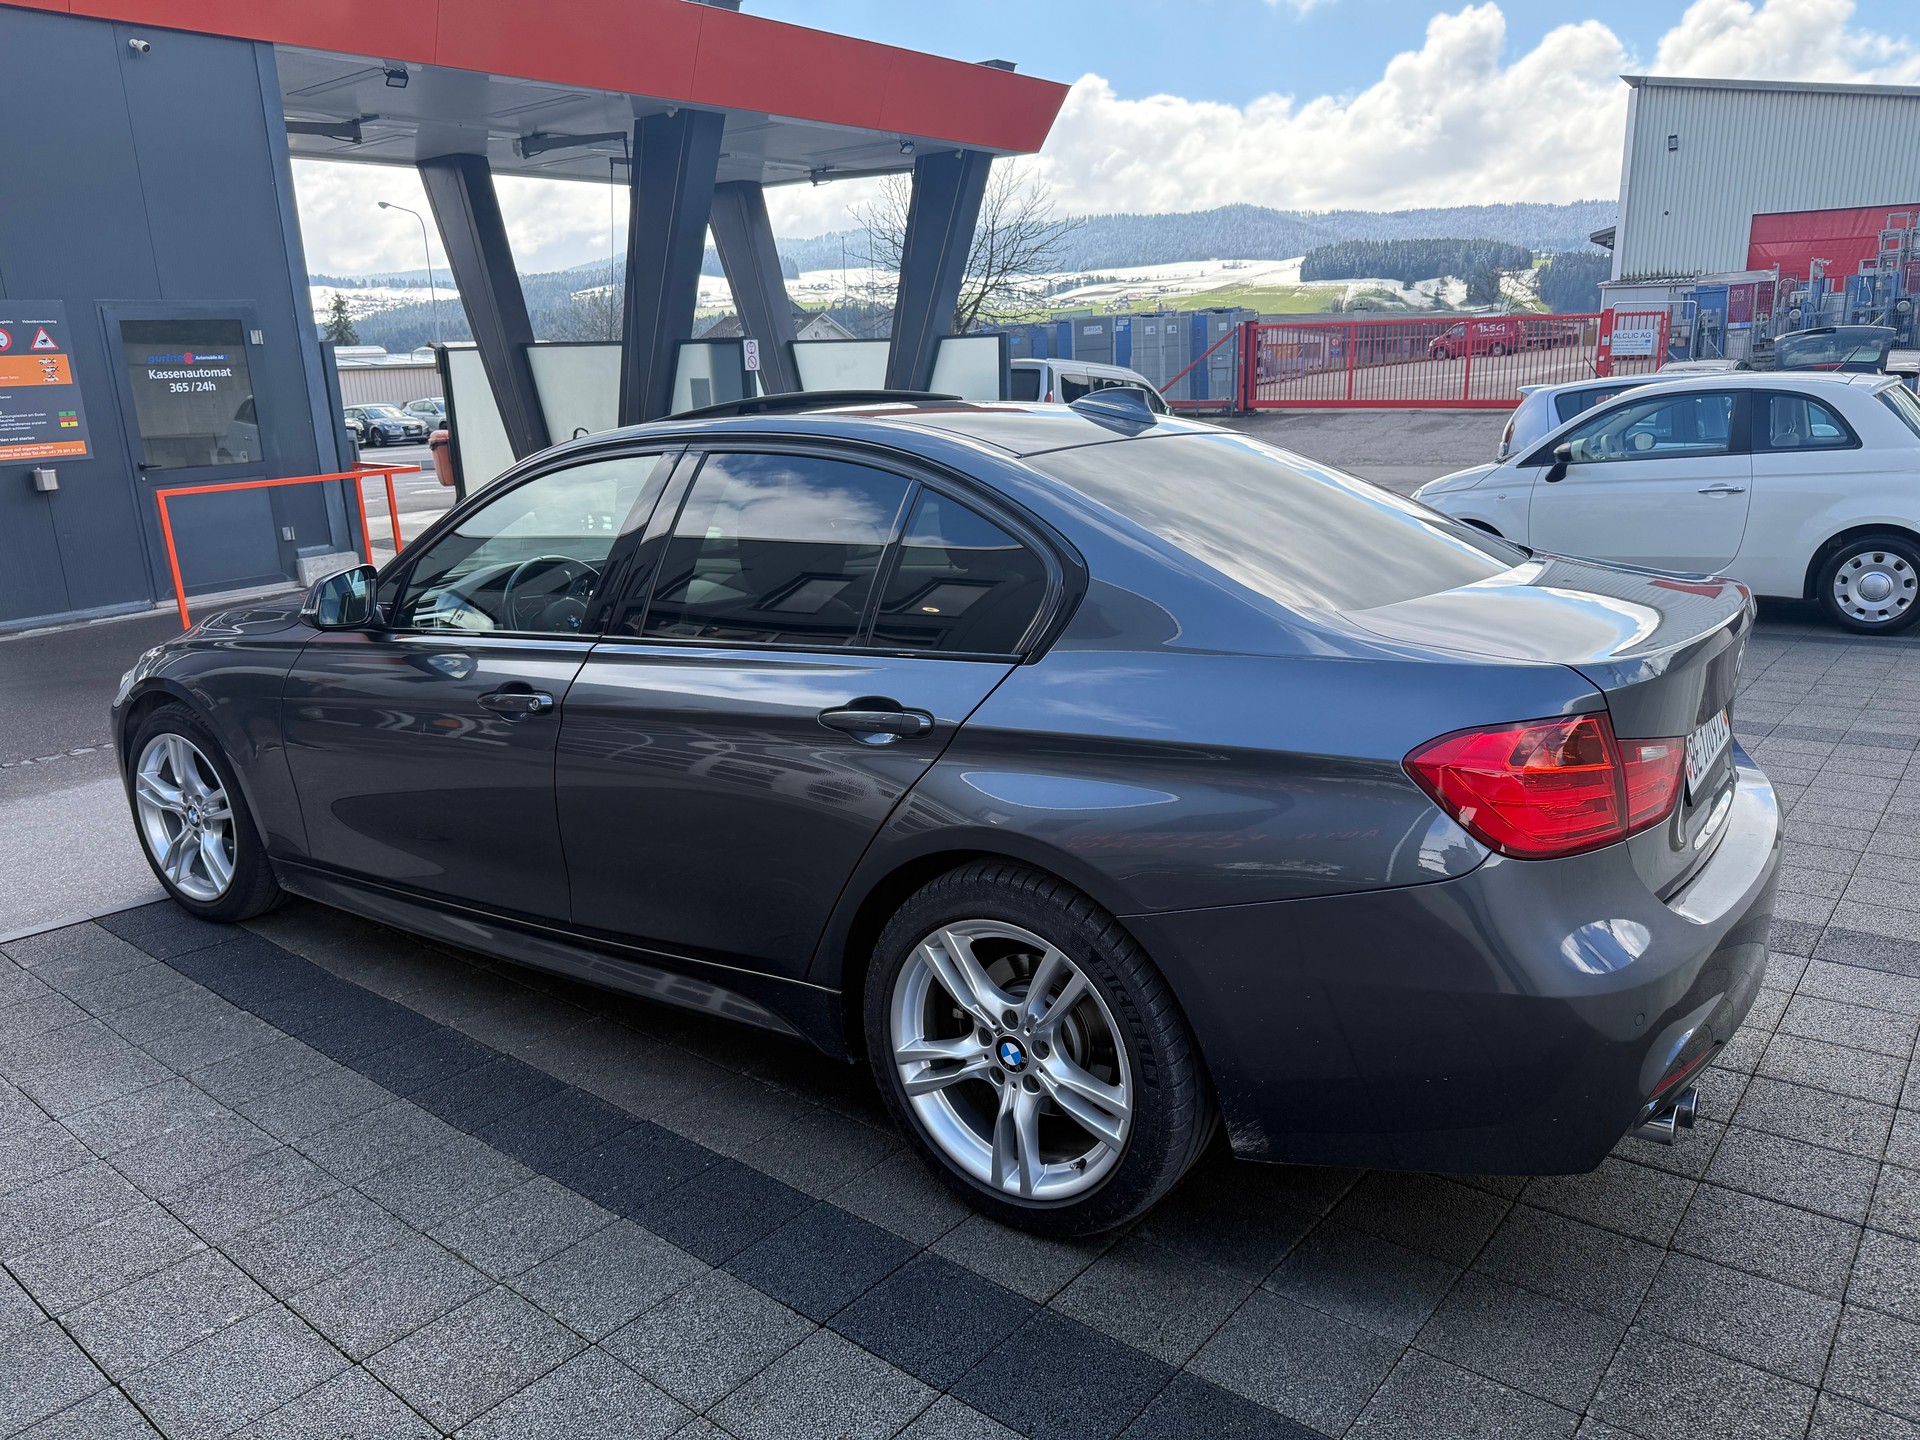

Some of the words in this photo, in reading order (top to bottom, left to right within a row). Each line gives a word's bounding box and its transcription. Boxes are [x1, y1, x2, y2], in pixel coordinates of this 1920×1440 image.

[148, 368, 232, 380] Kassenautomat
[170, 382, 189, 392] 365
[196, 382, 216, 392] 24h
